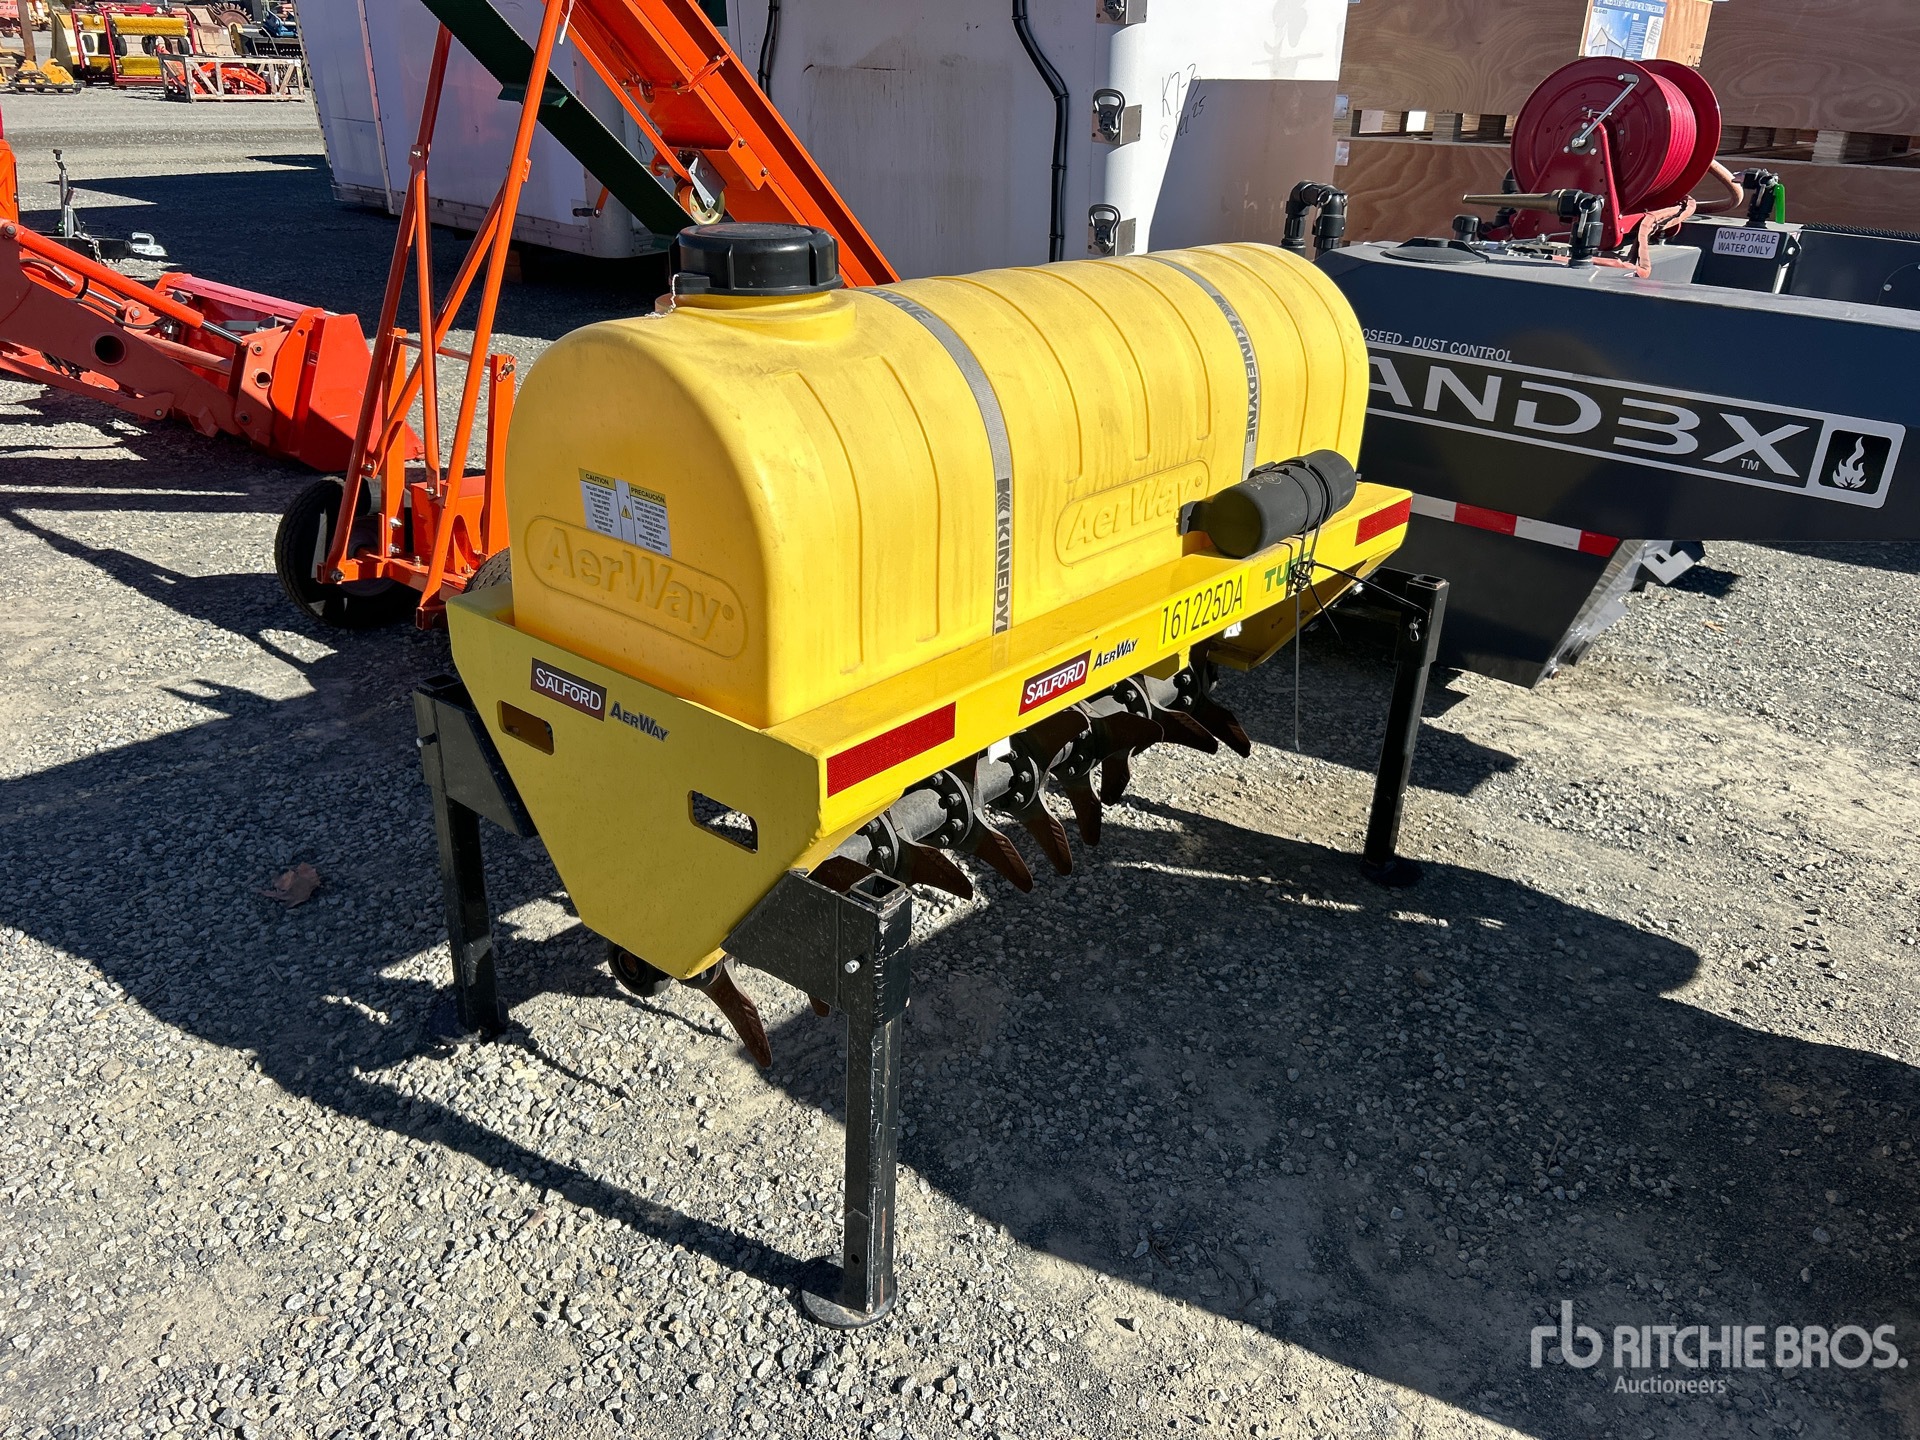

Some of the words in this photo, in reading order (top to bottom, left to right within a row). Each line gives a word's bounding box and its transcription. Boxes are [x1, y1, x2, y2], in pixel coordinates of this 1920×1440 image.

[1718, 230, 1777, 245] NON-POTABLE
[1718, 242, 1746, 253] WATER
[1747, 244, 1771, 255] ONLY
[1412, 335, 1448, 352] DUST
[1450, 341, 1513, 363] CONTROL
[1230, 320, 1258, 443] KINEDYNE
[1740, 458, 1760, 472] TM
[585, 473, 609, 486] CAUTION
[1162, 575, 1243, 644] 161225DA
[535, 667, 602, 711] SALFORD
[1025, 660, 1086, 705] SALFORD
